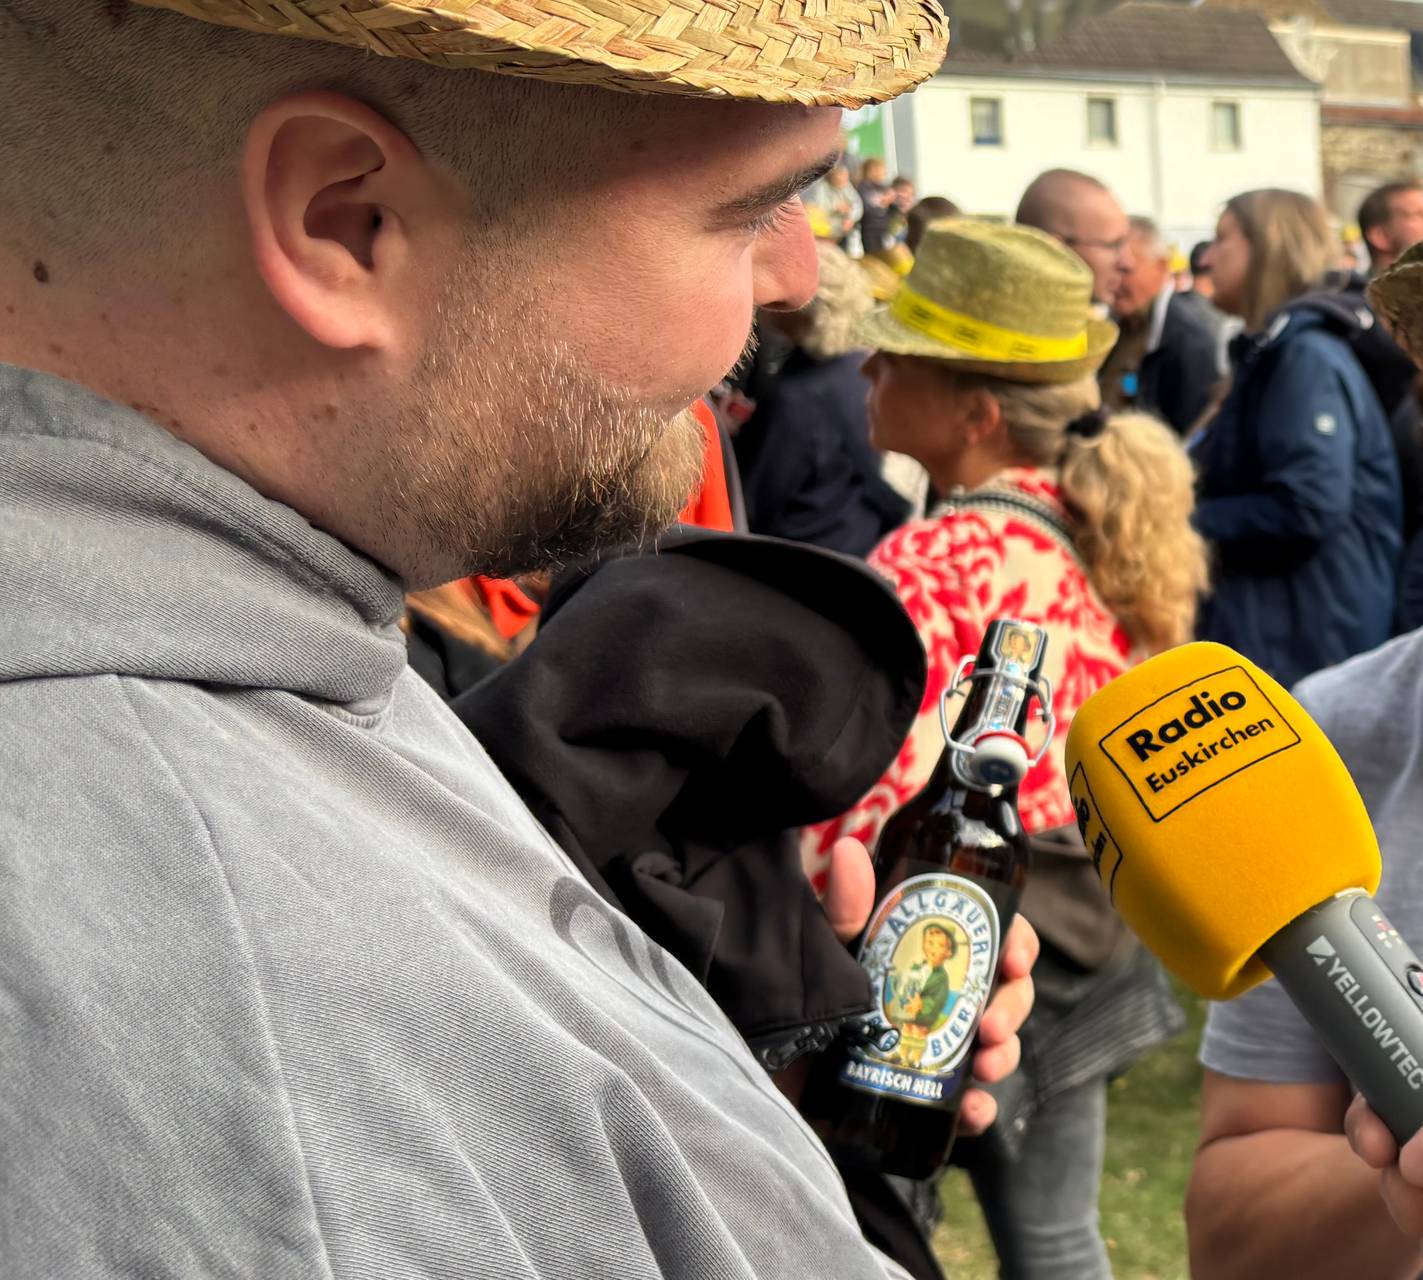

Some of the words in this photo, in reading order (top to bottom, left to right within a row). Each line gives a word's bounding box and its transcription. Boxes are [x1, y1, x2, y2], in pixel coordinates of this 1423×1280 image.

[1126, 690, 1247, 762] Radio
[1145, 717, 1275, 793] Euskirchen
[930, 1007, 972, 1058] BIER
[846, 1061, 913, 1092] BAYRISCH
[912, 1078, 944, 1099] HELL
